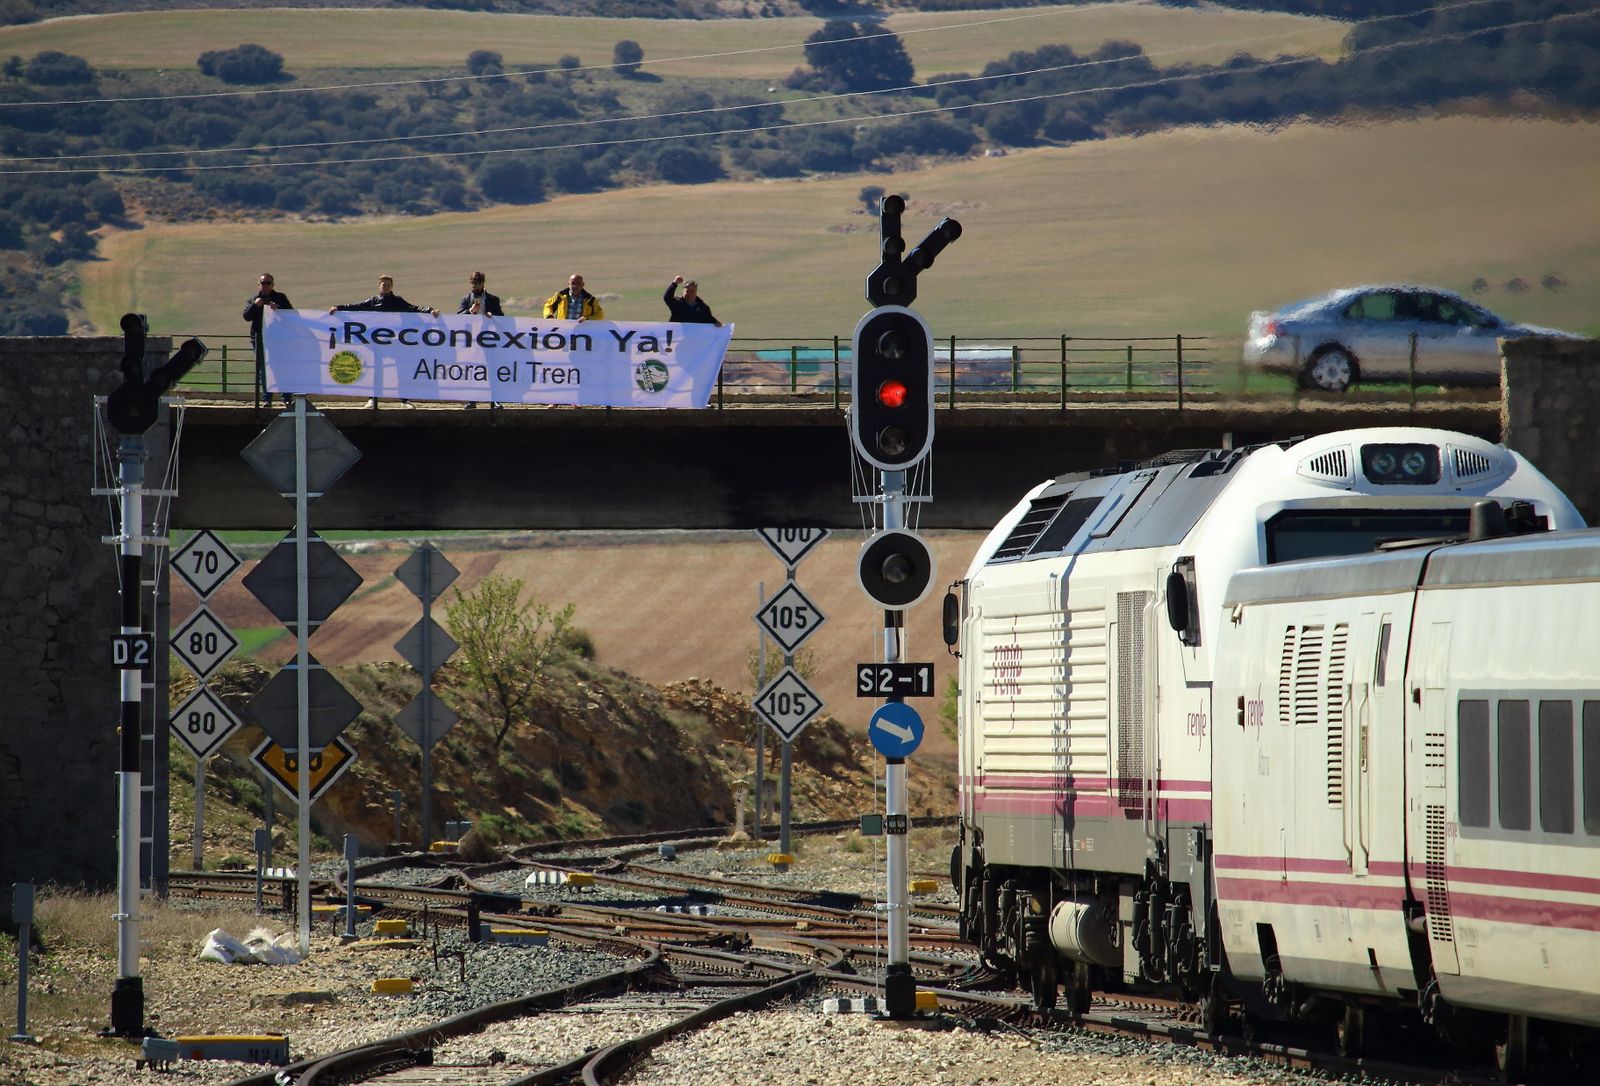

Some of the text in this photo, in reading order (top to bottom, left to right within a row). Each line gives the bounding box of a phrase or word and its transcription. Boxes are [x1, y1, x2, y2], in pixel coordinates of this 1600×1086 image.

[328, 321, 673, 353] ¡Reconexión Ya!
[413, 358, 581, 385] Ahora el Tren
[192, 551, 218, 574] 70
[769, 605, 808, 629] 105
[113, 640, 149, 664] D2
[189, 632, 218, 655] 80
[859, 667, 929, 693] S2-1
[768, 692, 806, 716] 105
[1246, 683, 1264, 742] renfe
[187, 711, 216, 734] 80
[1186, 698, 1207, 752] renfe
